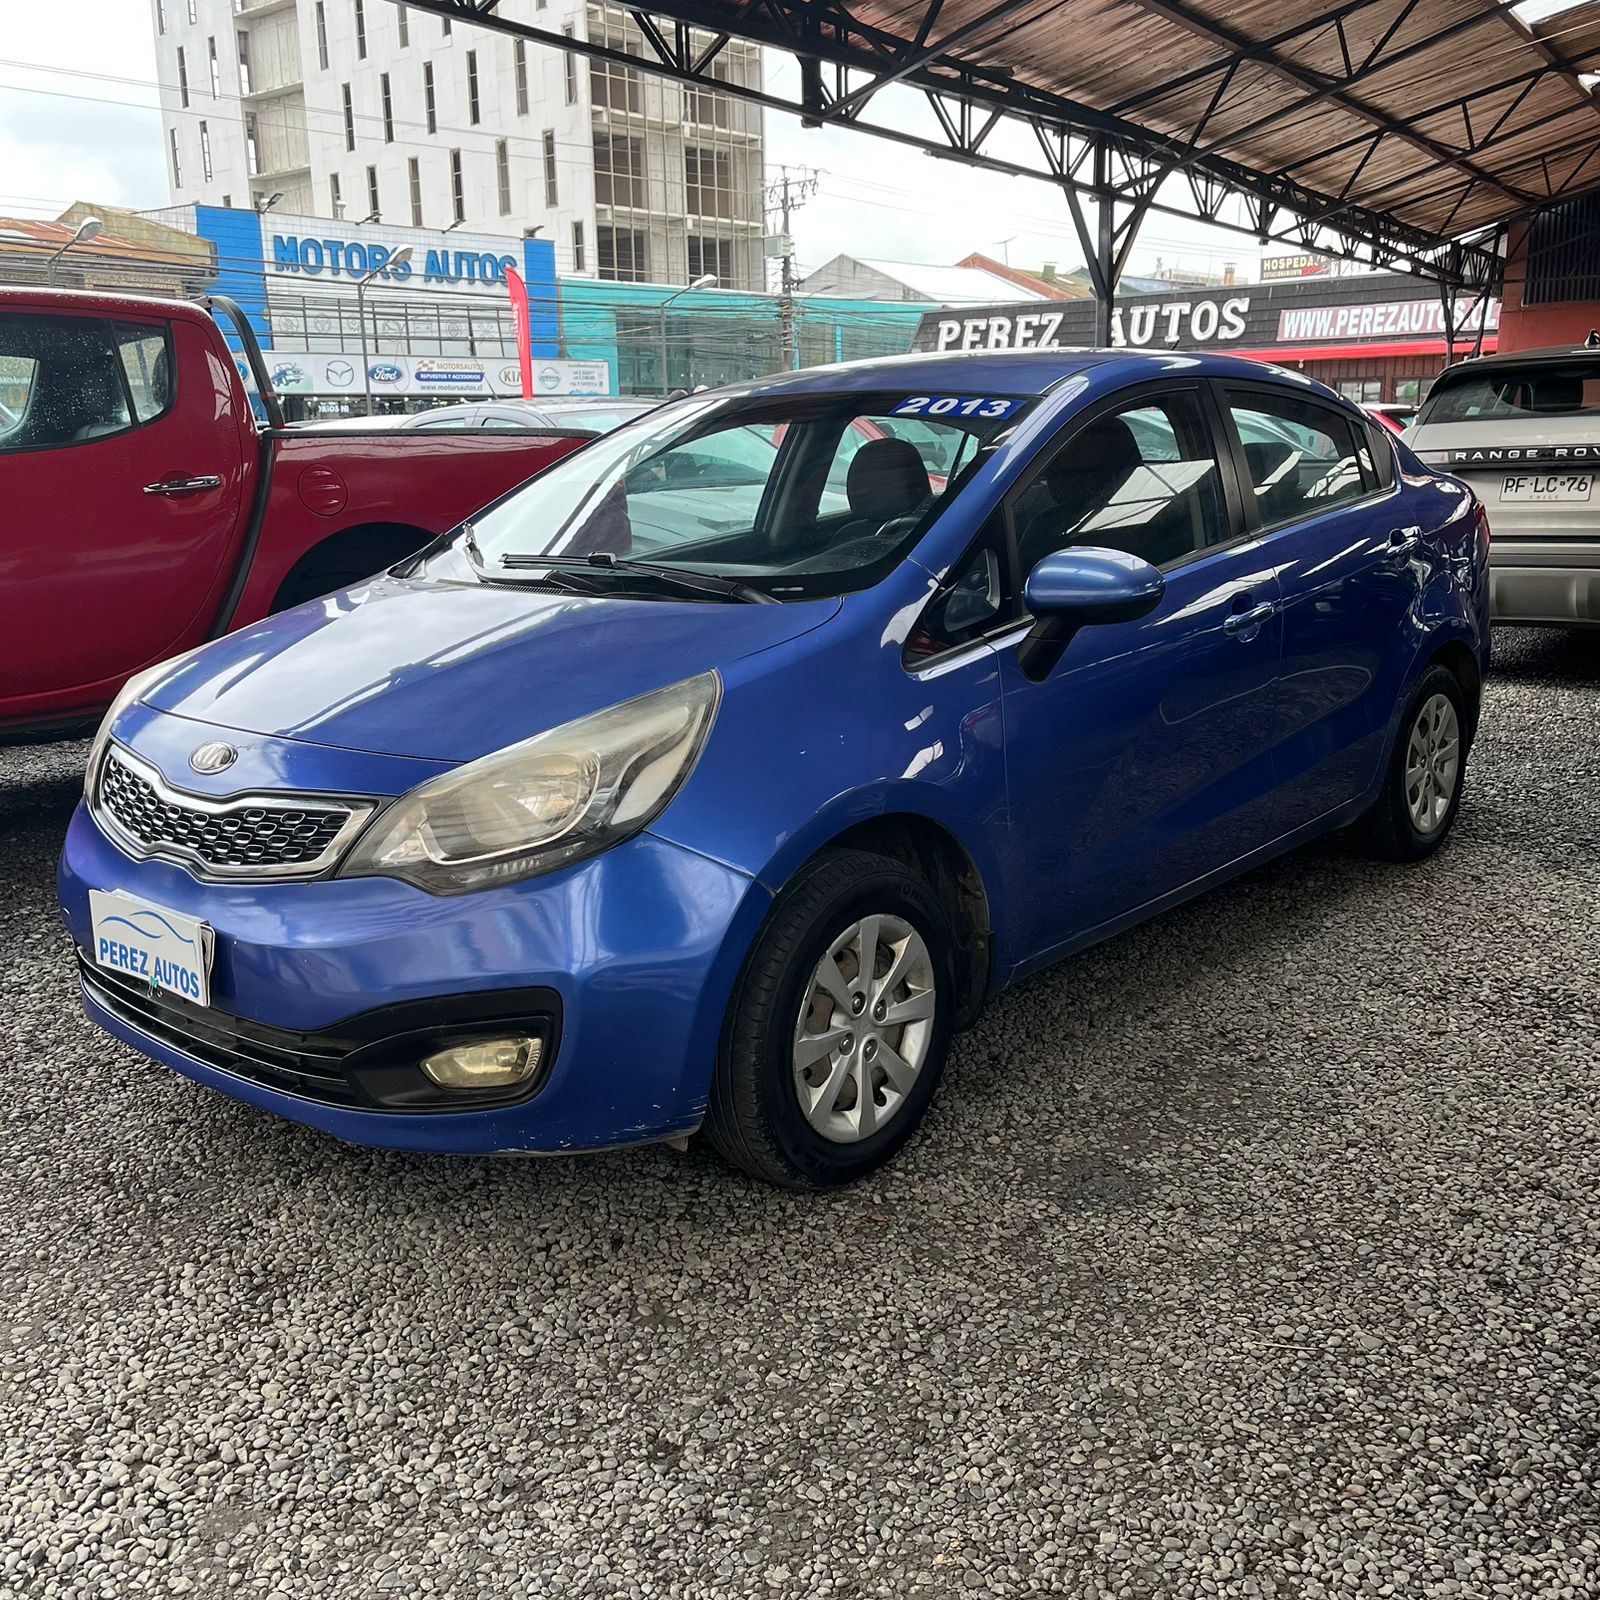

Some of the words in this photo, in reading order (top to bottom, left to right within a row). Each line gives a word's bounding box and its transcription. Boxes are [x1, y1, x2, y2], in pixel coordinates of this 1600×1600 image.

[938, 312, 1063, 351] PEREZ
[374, 367, 397, 380] Ford
[895, 397, 1012, 417] 2013
[1455, 449, 1538, 461] RANGE
[99, 937, 149, 977] PEREZ
[153, 956, 200, 999] AUTOS
